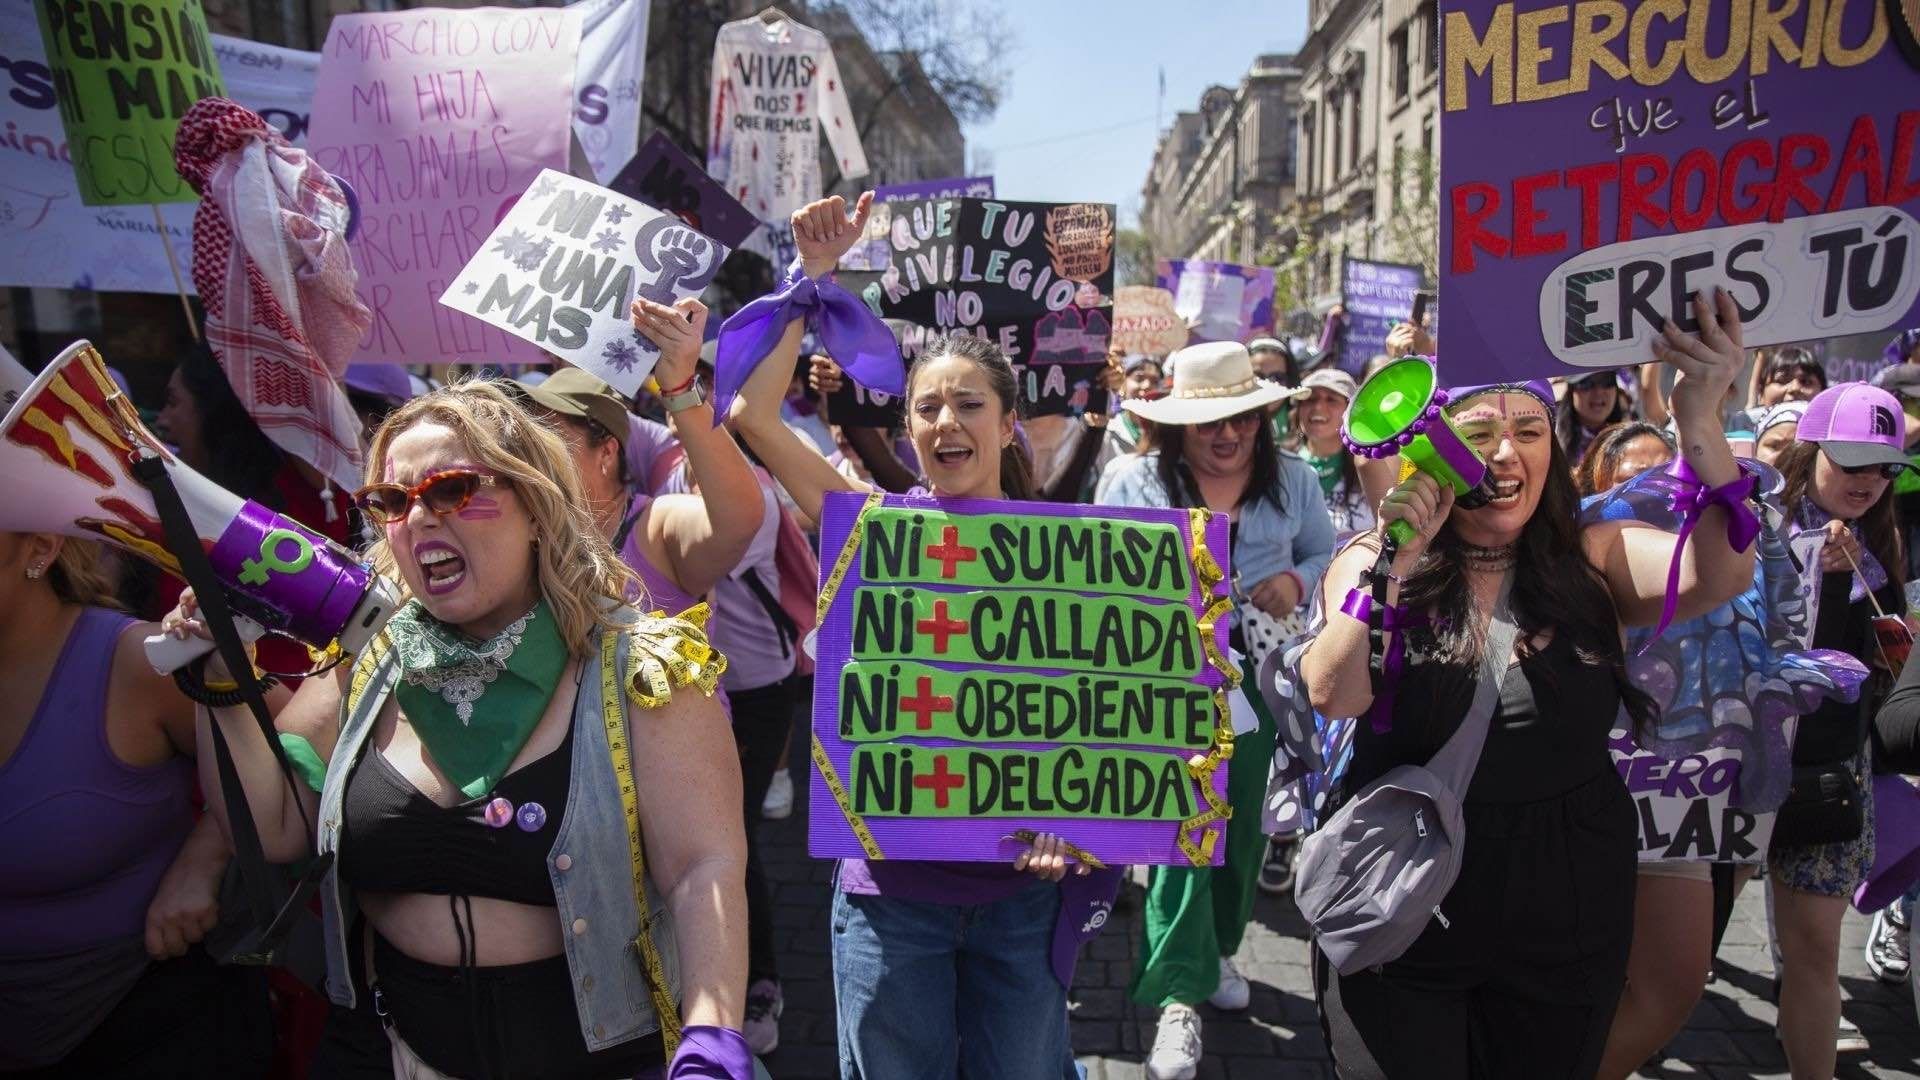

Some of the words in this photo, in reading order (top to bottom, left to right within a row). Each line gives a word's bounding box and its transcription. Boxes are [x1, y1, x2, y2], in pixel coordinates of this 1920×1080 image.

[336, 20, 480, 61] MARCHO
[493, 16, 563, 53] CON
[737, 53, 813, 89] VIVAS
[1445, 0, 1889, 112] MERCURIO
[352, 80, 392, 125] MI
[413, 69, 499, 122] HIJA
[397, 124, 508, 202] JAMAS
[536, 188, 607, 240] NI
[891, 200, 953, 251] QUE
[981, 202, 1035, 248] TU
[477, 273, 593, 350] MAS
[539, 246, 635, 322] UNA
[935, 290, 984, 327] NO
[1564, 239, 1770, 349] ERES
[1810, 214, 1908, 317] TÚ
[970, 595, 1197, 672] CALLADA
[968, 748, 1192, 818] DELGADA
[1637, 797, 1759, 861] LAR
